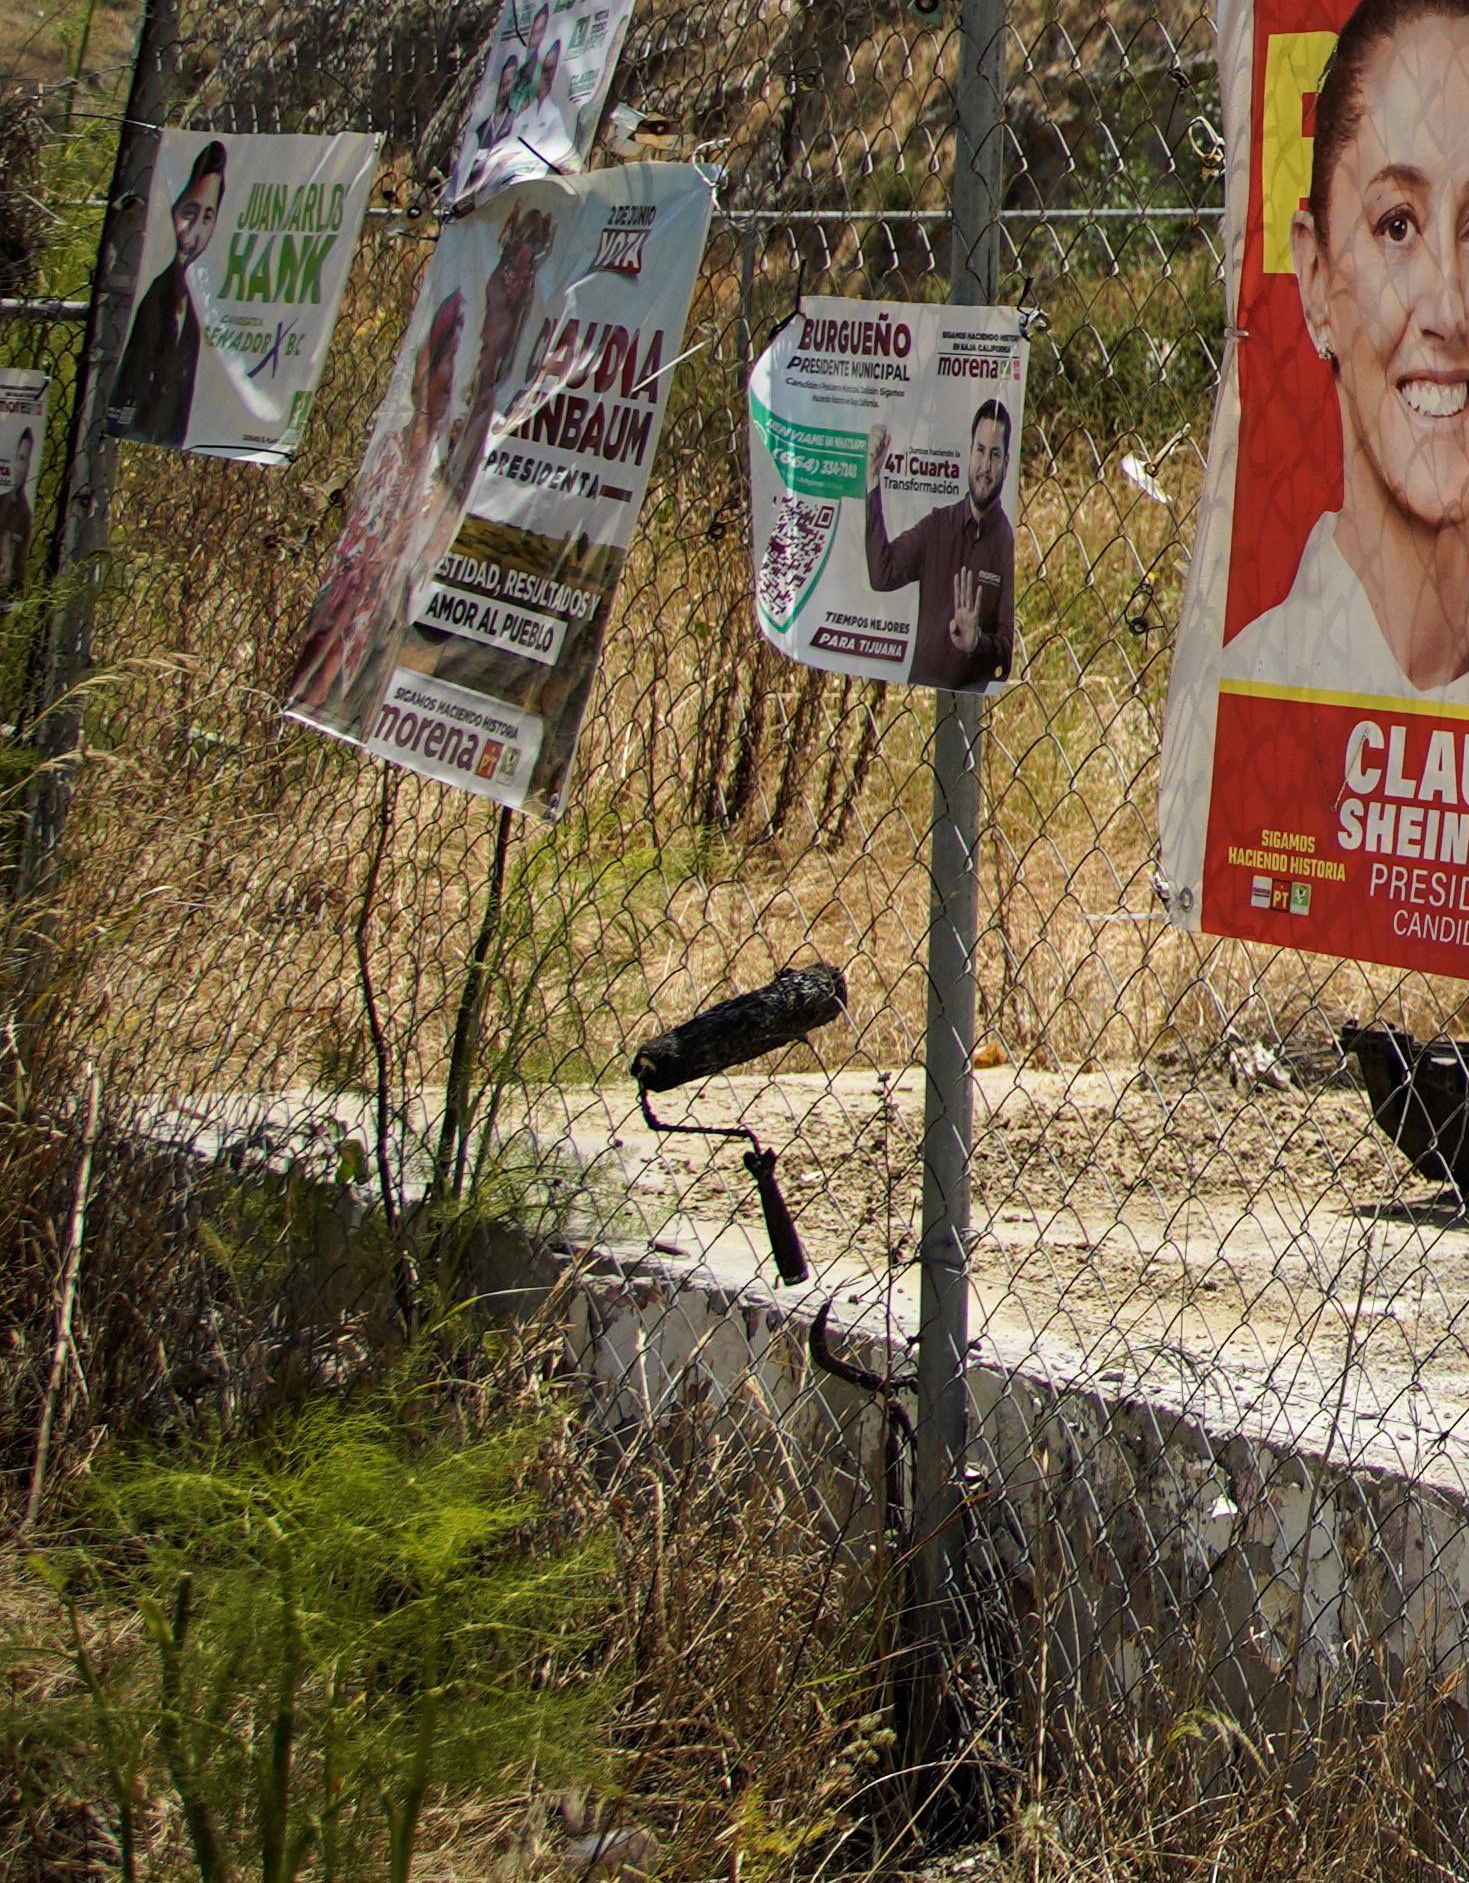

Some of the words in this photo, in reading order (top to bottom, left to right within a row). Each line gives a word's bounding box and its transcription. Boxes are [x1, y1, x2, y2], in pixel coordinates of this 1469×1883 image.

[236, 183, 287, 231] JUAN
[607, 205, 616, 225] 2
[614, 206, 630, 225] DE
[627, 205, 656, 226] JUNIO
[594, 231, 646, 268] VOTA
[216, 232, 338, 304] HANK
[798, 312, 911, 358] BURGUEÑO
[787, 356, 849, 376] PRESIDENTE
[851, 362, 910, 381] MUNICIPAL
[937, 356, 998, 379] morena
[482, 450, 600, 500] PRESIDENTA
[885, 453, 902, 473] 4T
[909, 457, 960, 479] Cuarta
[883, 476, 959, 495] Transformación
[503, 570, 590, 618] RESULTADOS
[588, 595, 601, 621] Y
[426, 592, 478, 629] AMOR
[477, 607, 498, 637] AL
[501, 613, 554, 653] PUEBLO
[825, 611, 869, 628] TIEMPOS
[870, 620, 909, 635] MEJORES
[819, 633, 855, 651] PARA
[859, 639, 902, 658] TIJUANA
[374, 704, 479, 771] morena
[1262, 830, 1315, 853] SIGAMOS
[1228, 846, 1287, 872] HACIENDO
[1290, 856, 1346, 882] HISTORIA
